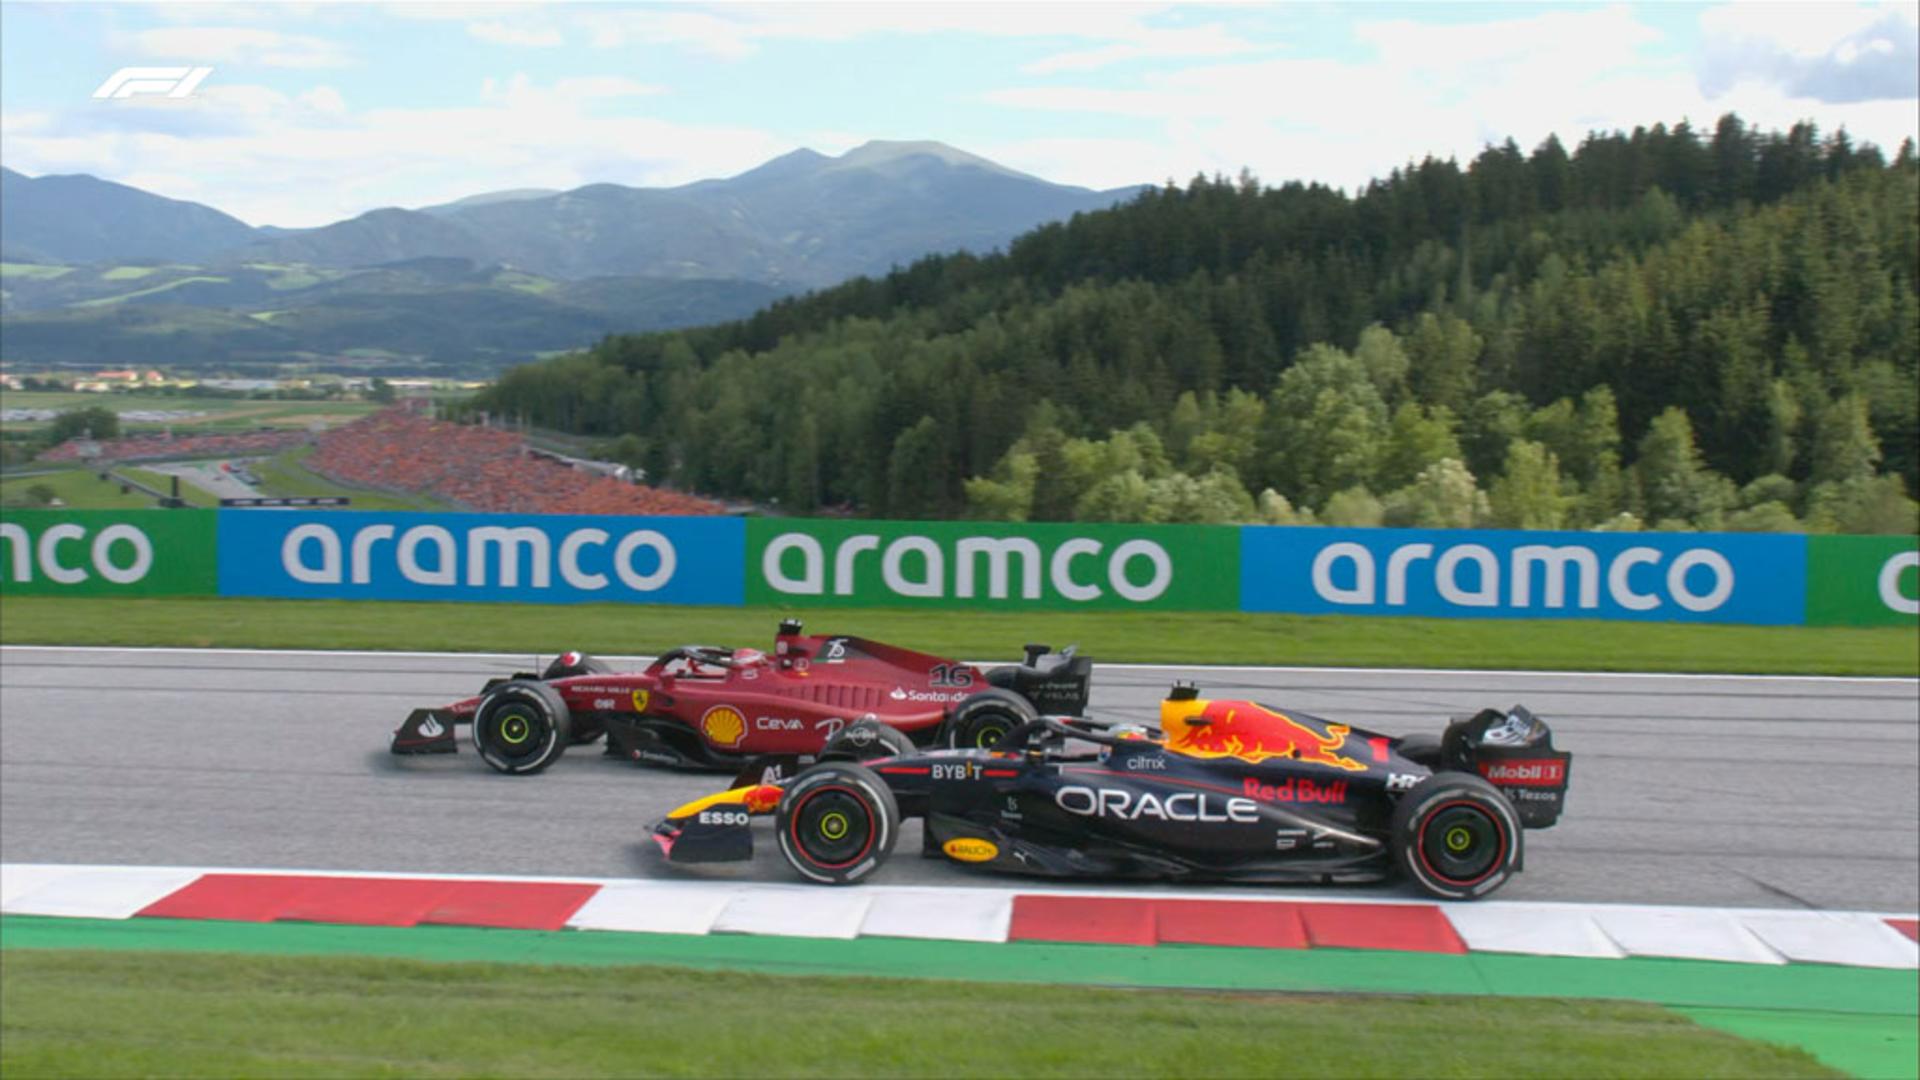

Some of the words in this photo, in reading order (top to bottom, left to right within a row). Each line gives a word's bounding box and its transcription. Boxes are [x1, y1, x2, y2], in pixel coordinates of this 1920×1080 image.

[282, 524, 676, 591] aramco
[763, 533, 1172, 601] aramco
[1312, 542, 1734, 611] aramco
[928, 663, 974, 688] 16
[908, 690, 970, 702] Santand
[1126, 755, 1167, 770] citrix
[1488, 764, 1541, 779] Mobil
[1243, 776, 1294, 801] Red
[1297, 779, 1348, 804] Bull
[1056, 786, 1260, 822] ORACLE
[699, 811, 749, 826] ESSO
